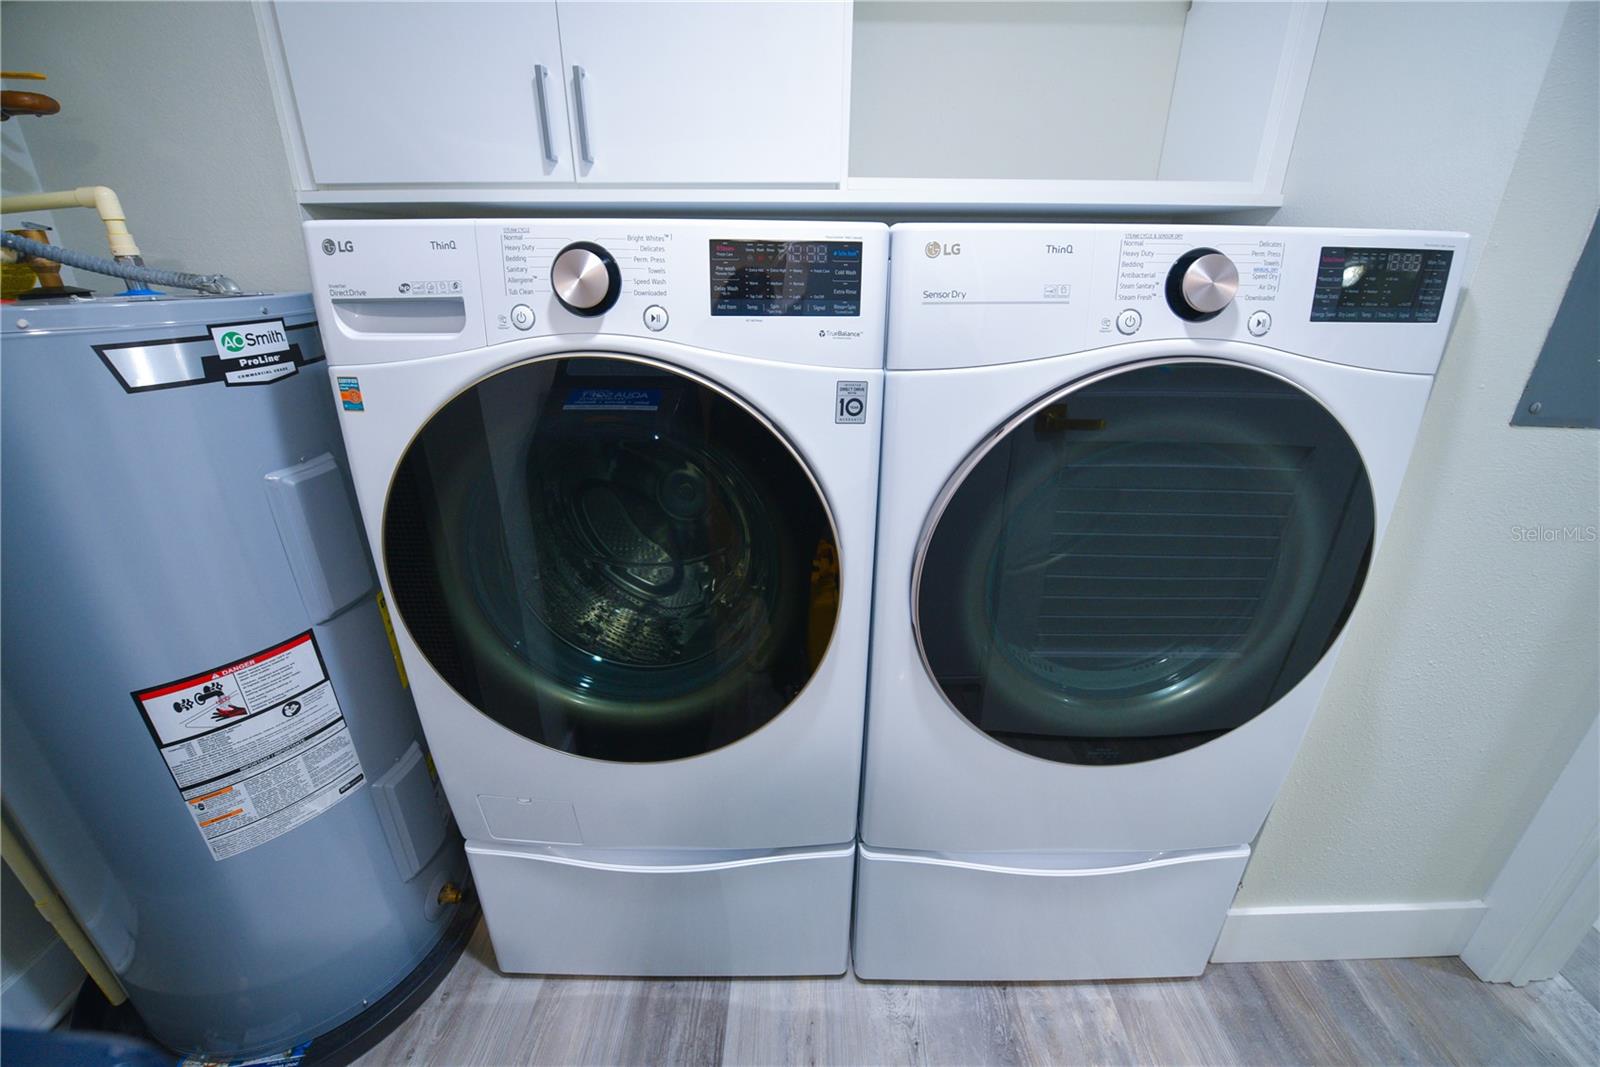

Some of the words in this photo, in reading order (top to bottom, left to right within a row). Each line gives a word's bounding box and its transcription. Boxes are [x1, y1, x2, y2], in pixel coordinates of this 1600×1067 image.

[627, 234, 643, 242] Bright
[337, 240, 354, 253] LG
[430, 240, 457, 250] ThinQ
[521, 244, 535, 252] Duty
[943, 243, 961, 256] LG
[1046, 244, 1073, 254] ThinQ
[1269, 272, 1278, 280] Dry
[839, 397, 864, 417] 10
[221, 660, 255, 675] DANGER
